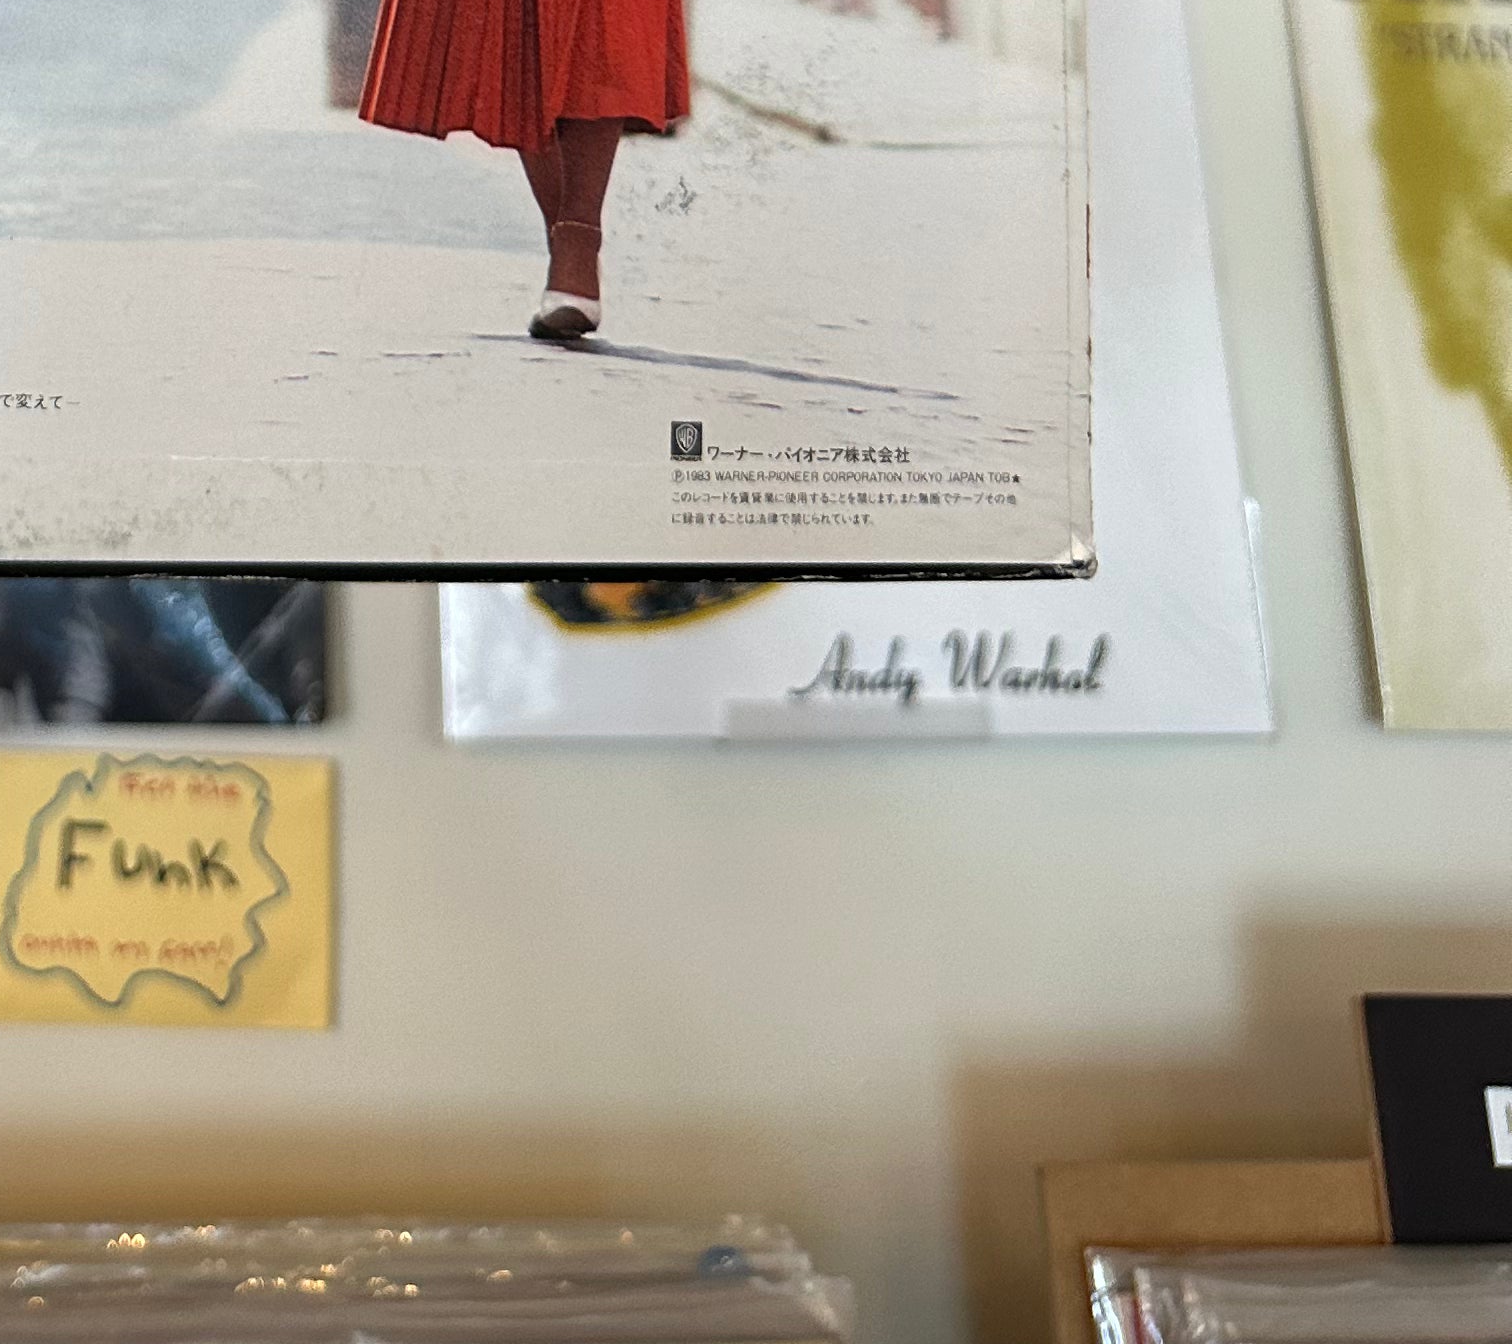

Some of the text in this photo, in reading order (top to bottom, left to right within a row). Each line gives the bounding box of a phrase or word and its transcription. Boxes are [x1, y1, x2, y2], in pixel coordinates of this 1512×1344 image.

[822, 470, 902, 483] CORPORATION
[906, 471, 943, 483] TOKYO
[947, 471, 985, 483] JAPAN
[789, 627, 1112, 709] Andy Warhol
